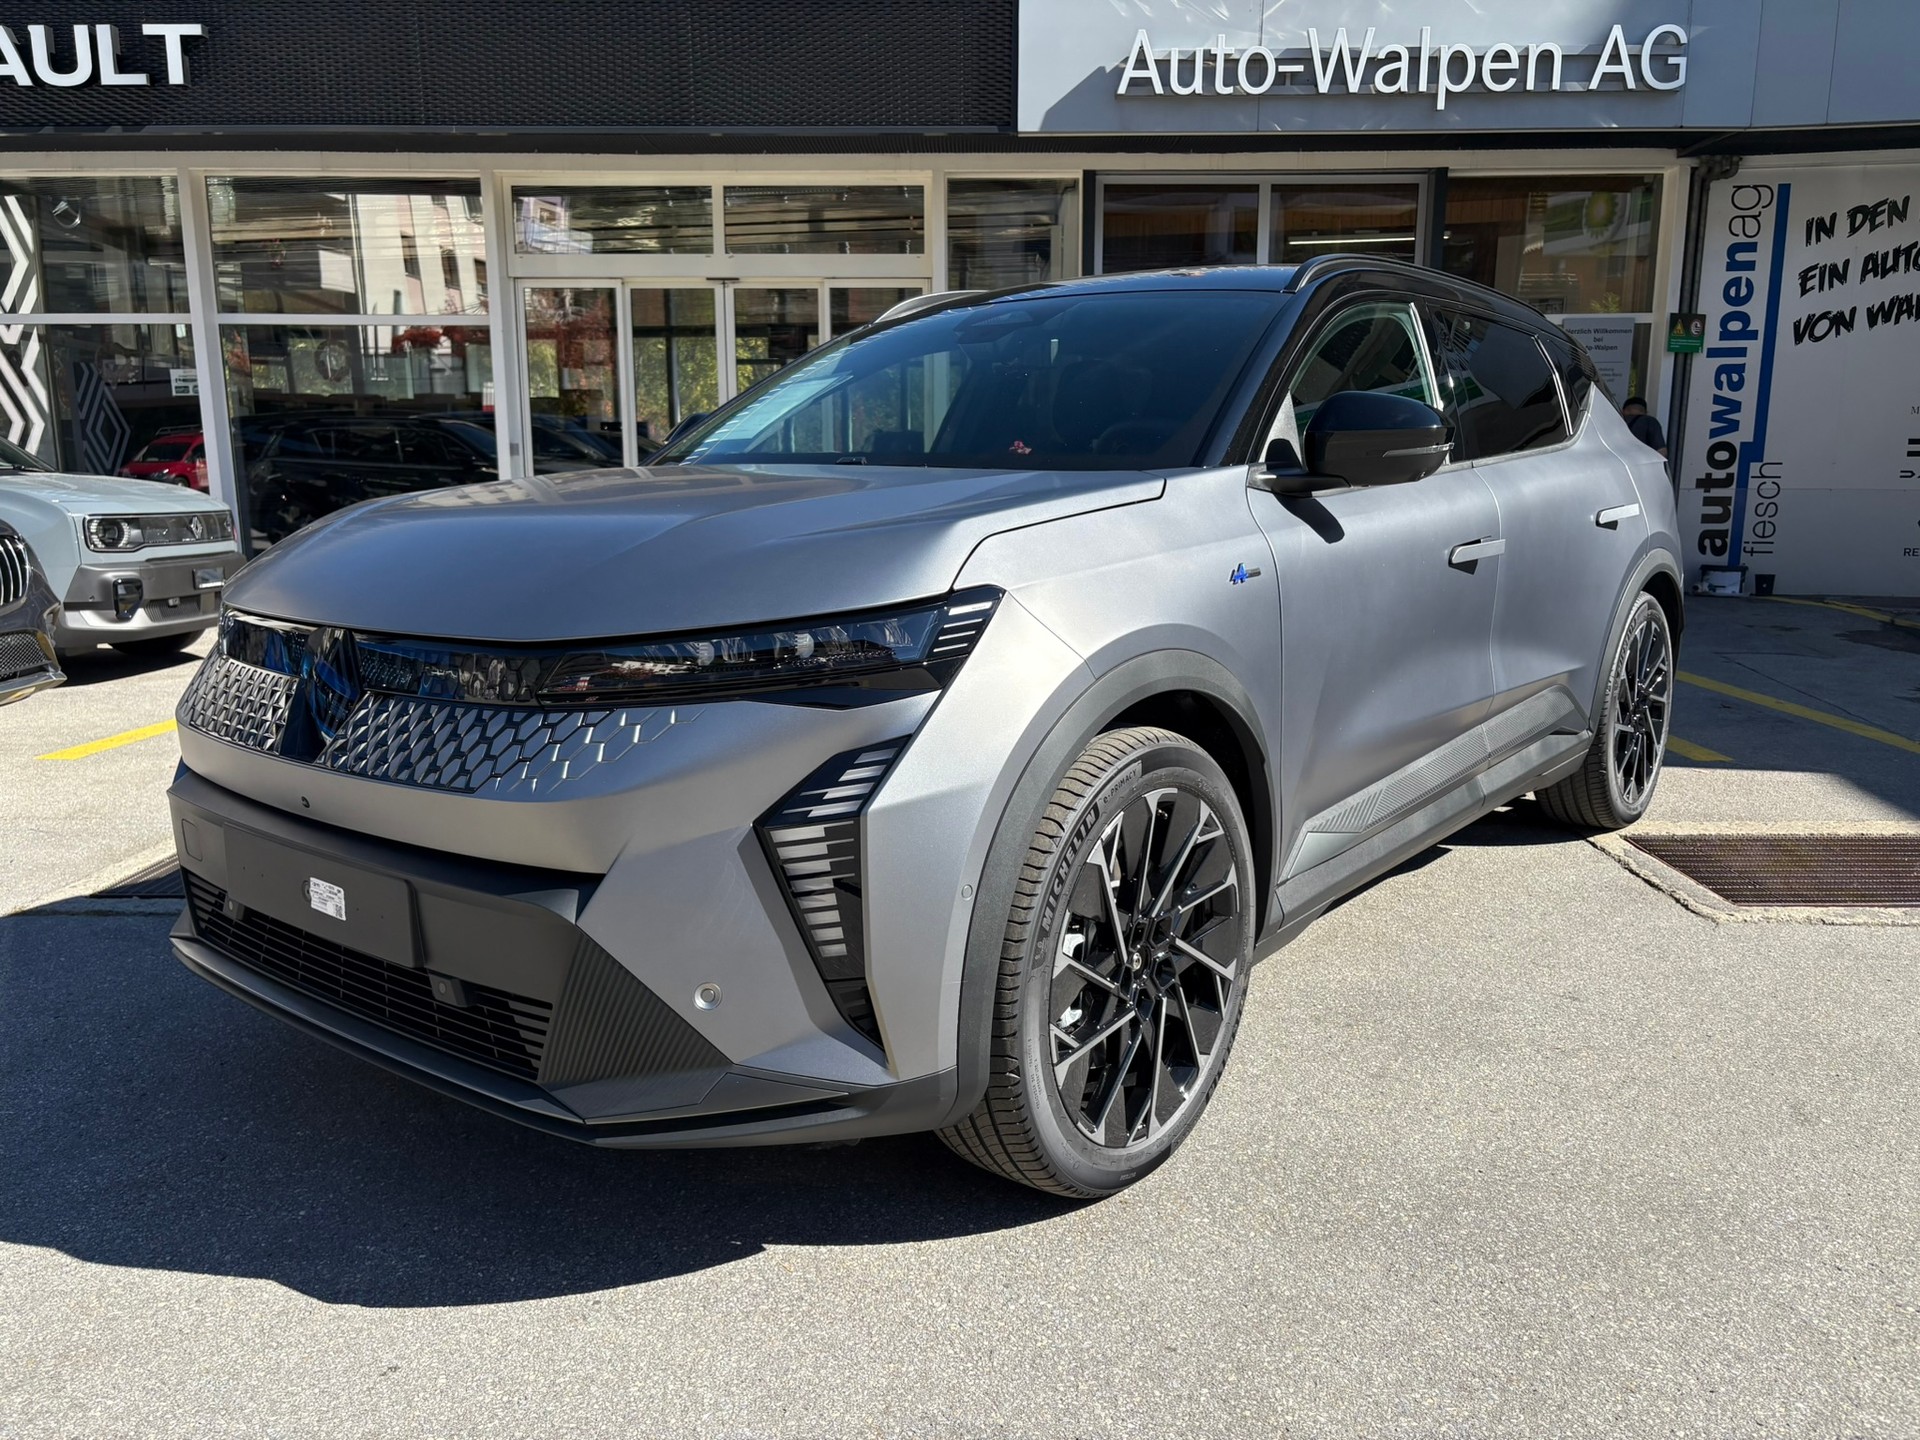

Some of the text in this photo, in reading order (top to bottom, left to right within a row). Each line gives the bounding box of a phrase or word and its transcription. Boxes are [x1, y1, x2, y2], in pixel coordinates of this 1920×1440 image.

[1116, 23, 1688, 110] Auto-Walpen AG
[1805, 195, 1910, 247] IN DEN
[1798, 258, 1850, 298] EIN
[1793, 306, 1857, 346] VON
[1743, 462, 1783, 557] fiesch
[1042, 808, 1097, 932] MICHELIN
